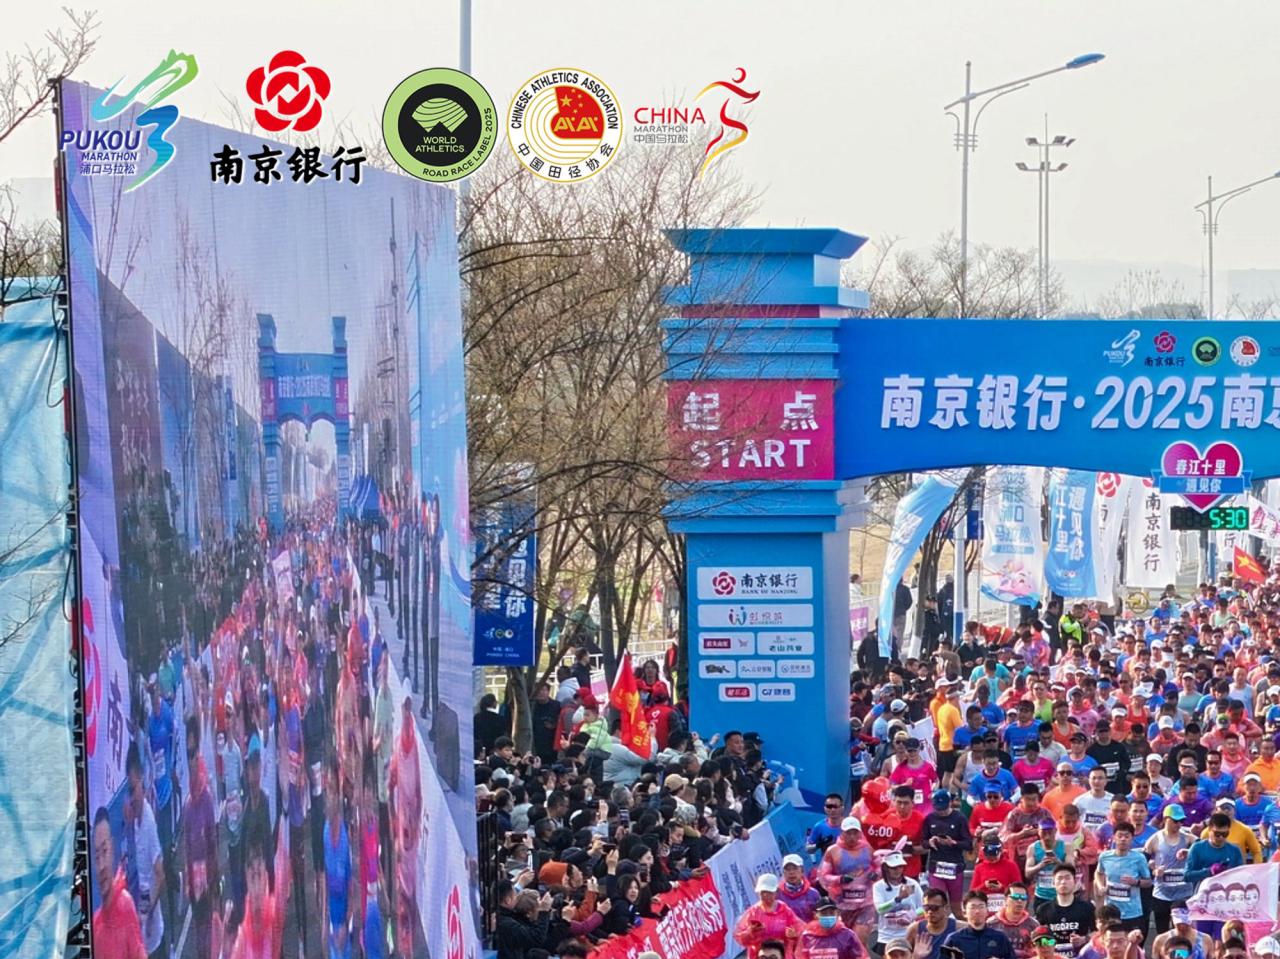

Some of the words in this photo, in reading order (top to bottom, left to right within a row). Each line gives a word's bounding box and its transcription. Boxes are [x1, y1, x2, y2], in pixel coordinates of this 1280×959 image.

[690, 440, 812, 468] START
[1175, 459, 1227, 475] 春江十里
[740, 573, 799, 588] 南京银行
[868, 825, 893, 838] 6:00
